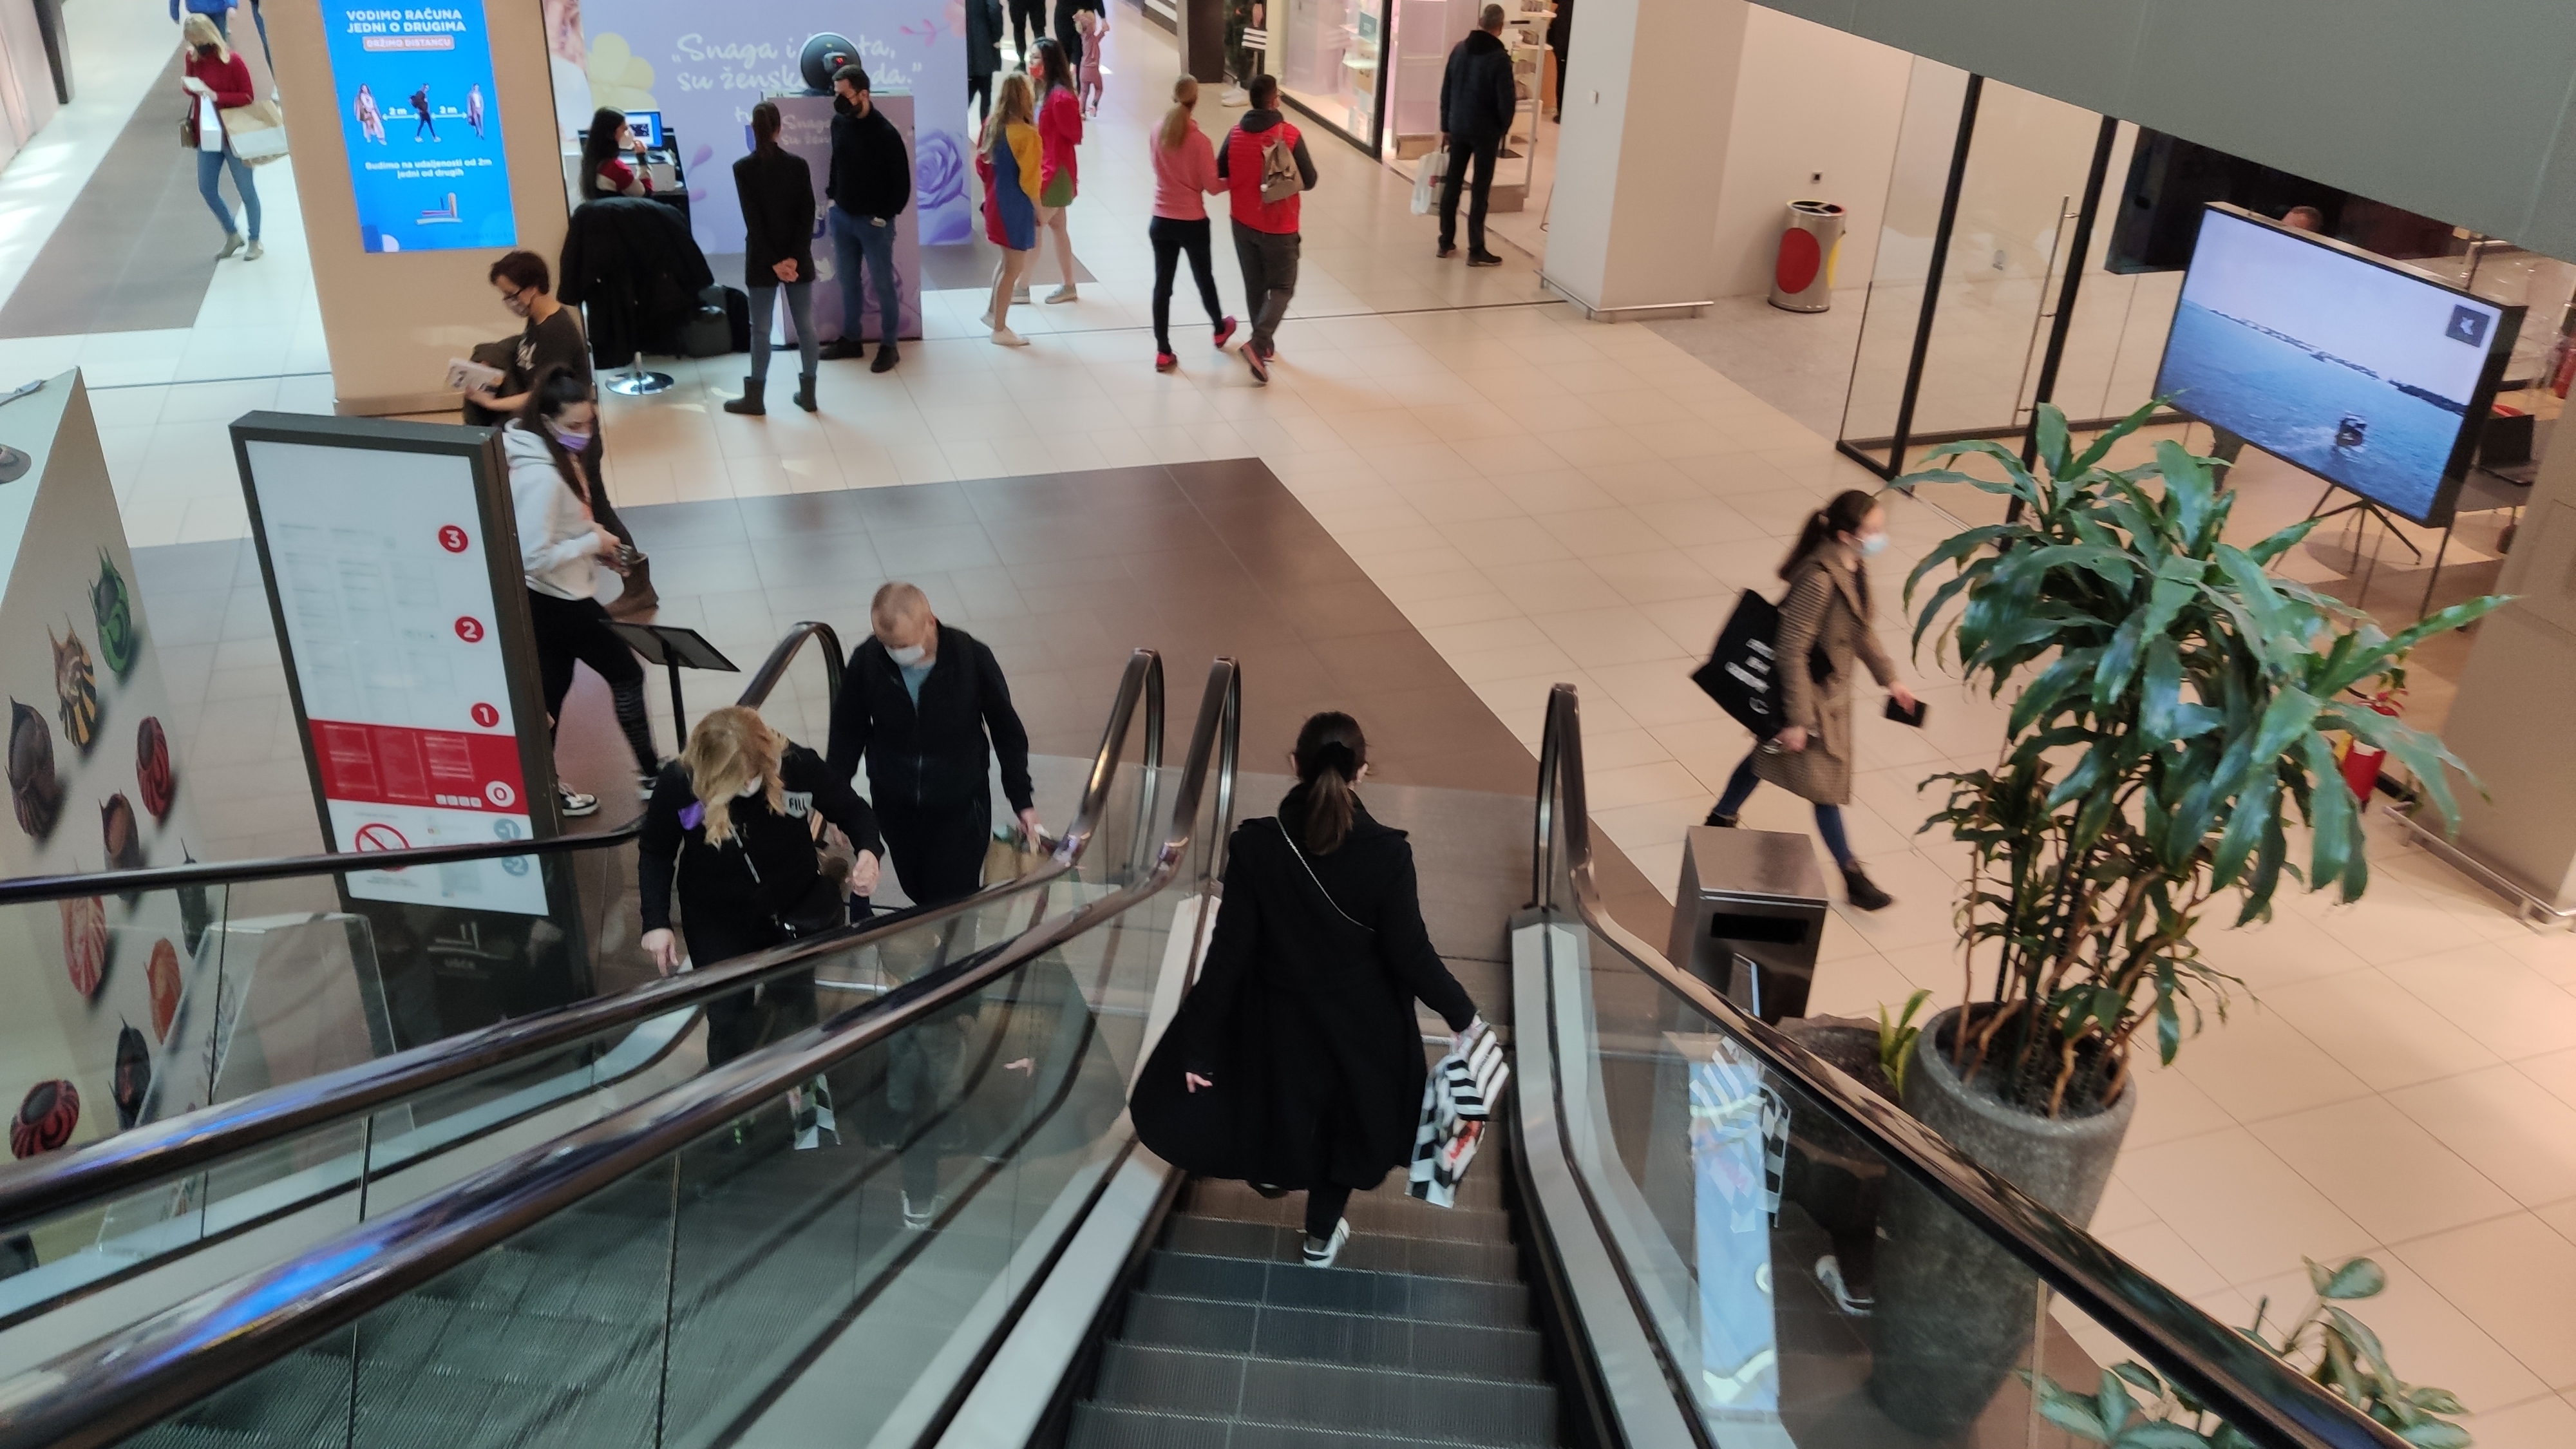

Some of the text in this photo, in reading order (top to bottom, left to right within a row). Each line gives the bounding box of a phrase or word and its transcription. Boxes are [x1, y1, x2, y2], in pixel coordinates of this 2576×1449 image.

[346, 7, 462, 21] VODIMO RAČUNA
[346, 21, 466, 33] JEDNI O DRUGIMA
[786, 37, 797, 59] i
[677, 72, 713, 91] su
[464, 158, 476, 167] od
[421, 169, 433, 177] od
[446, 529, 461, 548] 3
[462, 620, 477, 639] 2
[479, 706, 490, 724] 1
